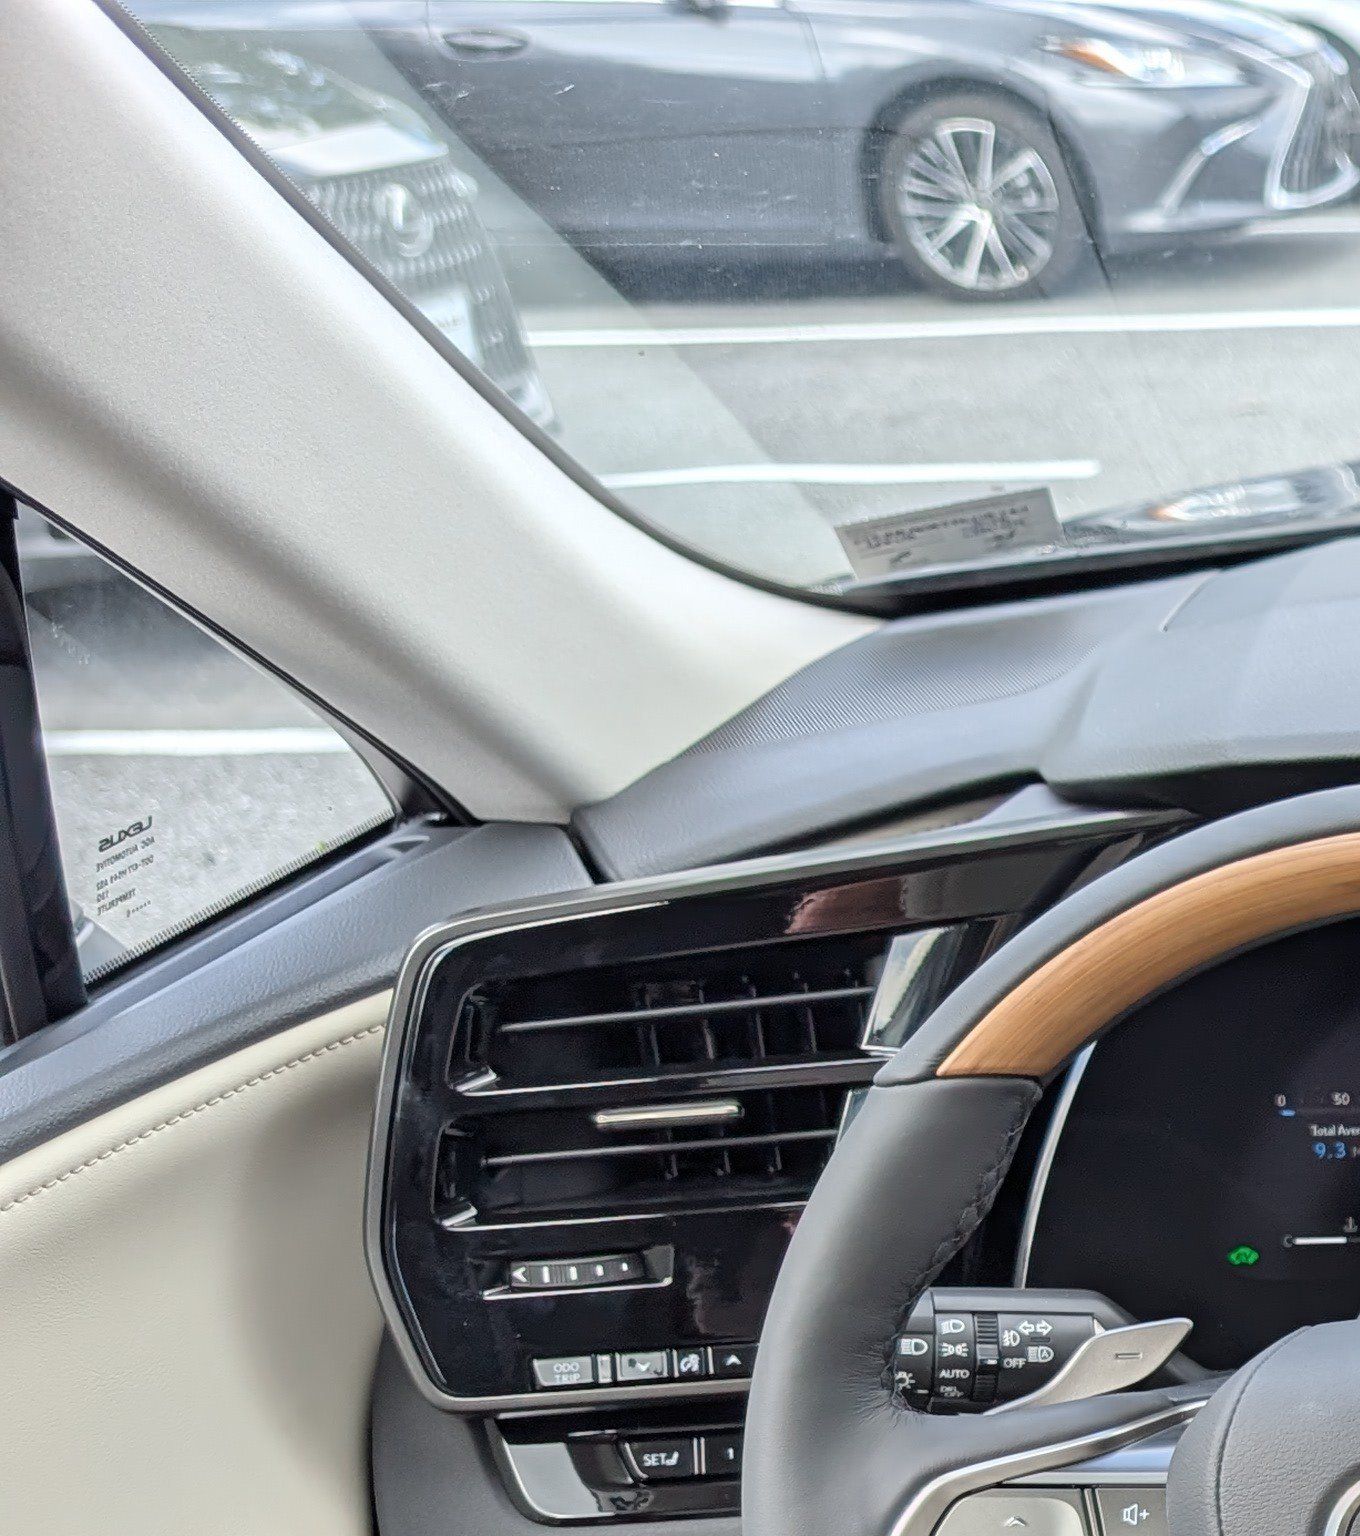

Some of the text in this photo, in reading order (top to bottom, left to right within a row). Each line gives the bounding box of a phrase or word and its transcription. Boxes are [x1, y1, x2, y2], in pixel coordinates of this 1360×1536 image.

[1275, 1093, 1287, 1107] 0
[1332, 1091, 1351, 1106] 50
[1309, 1124, 1336, 1137] Total
[1312, 1141, 1347, 1159] 9.3
[553, 1362, 580, 1374] ODO
[1003, 1357, 1027, 1369] OFF
[554, 1372, 581, 1383] TRIP
[939, 1368, 971, 1379] AUTO
[642, 1452, 666, 1467] SET
